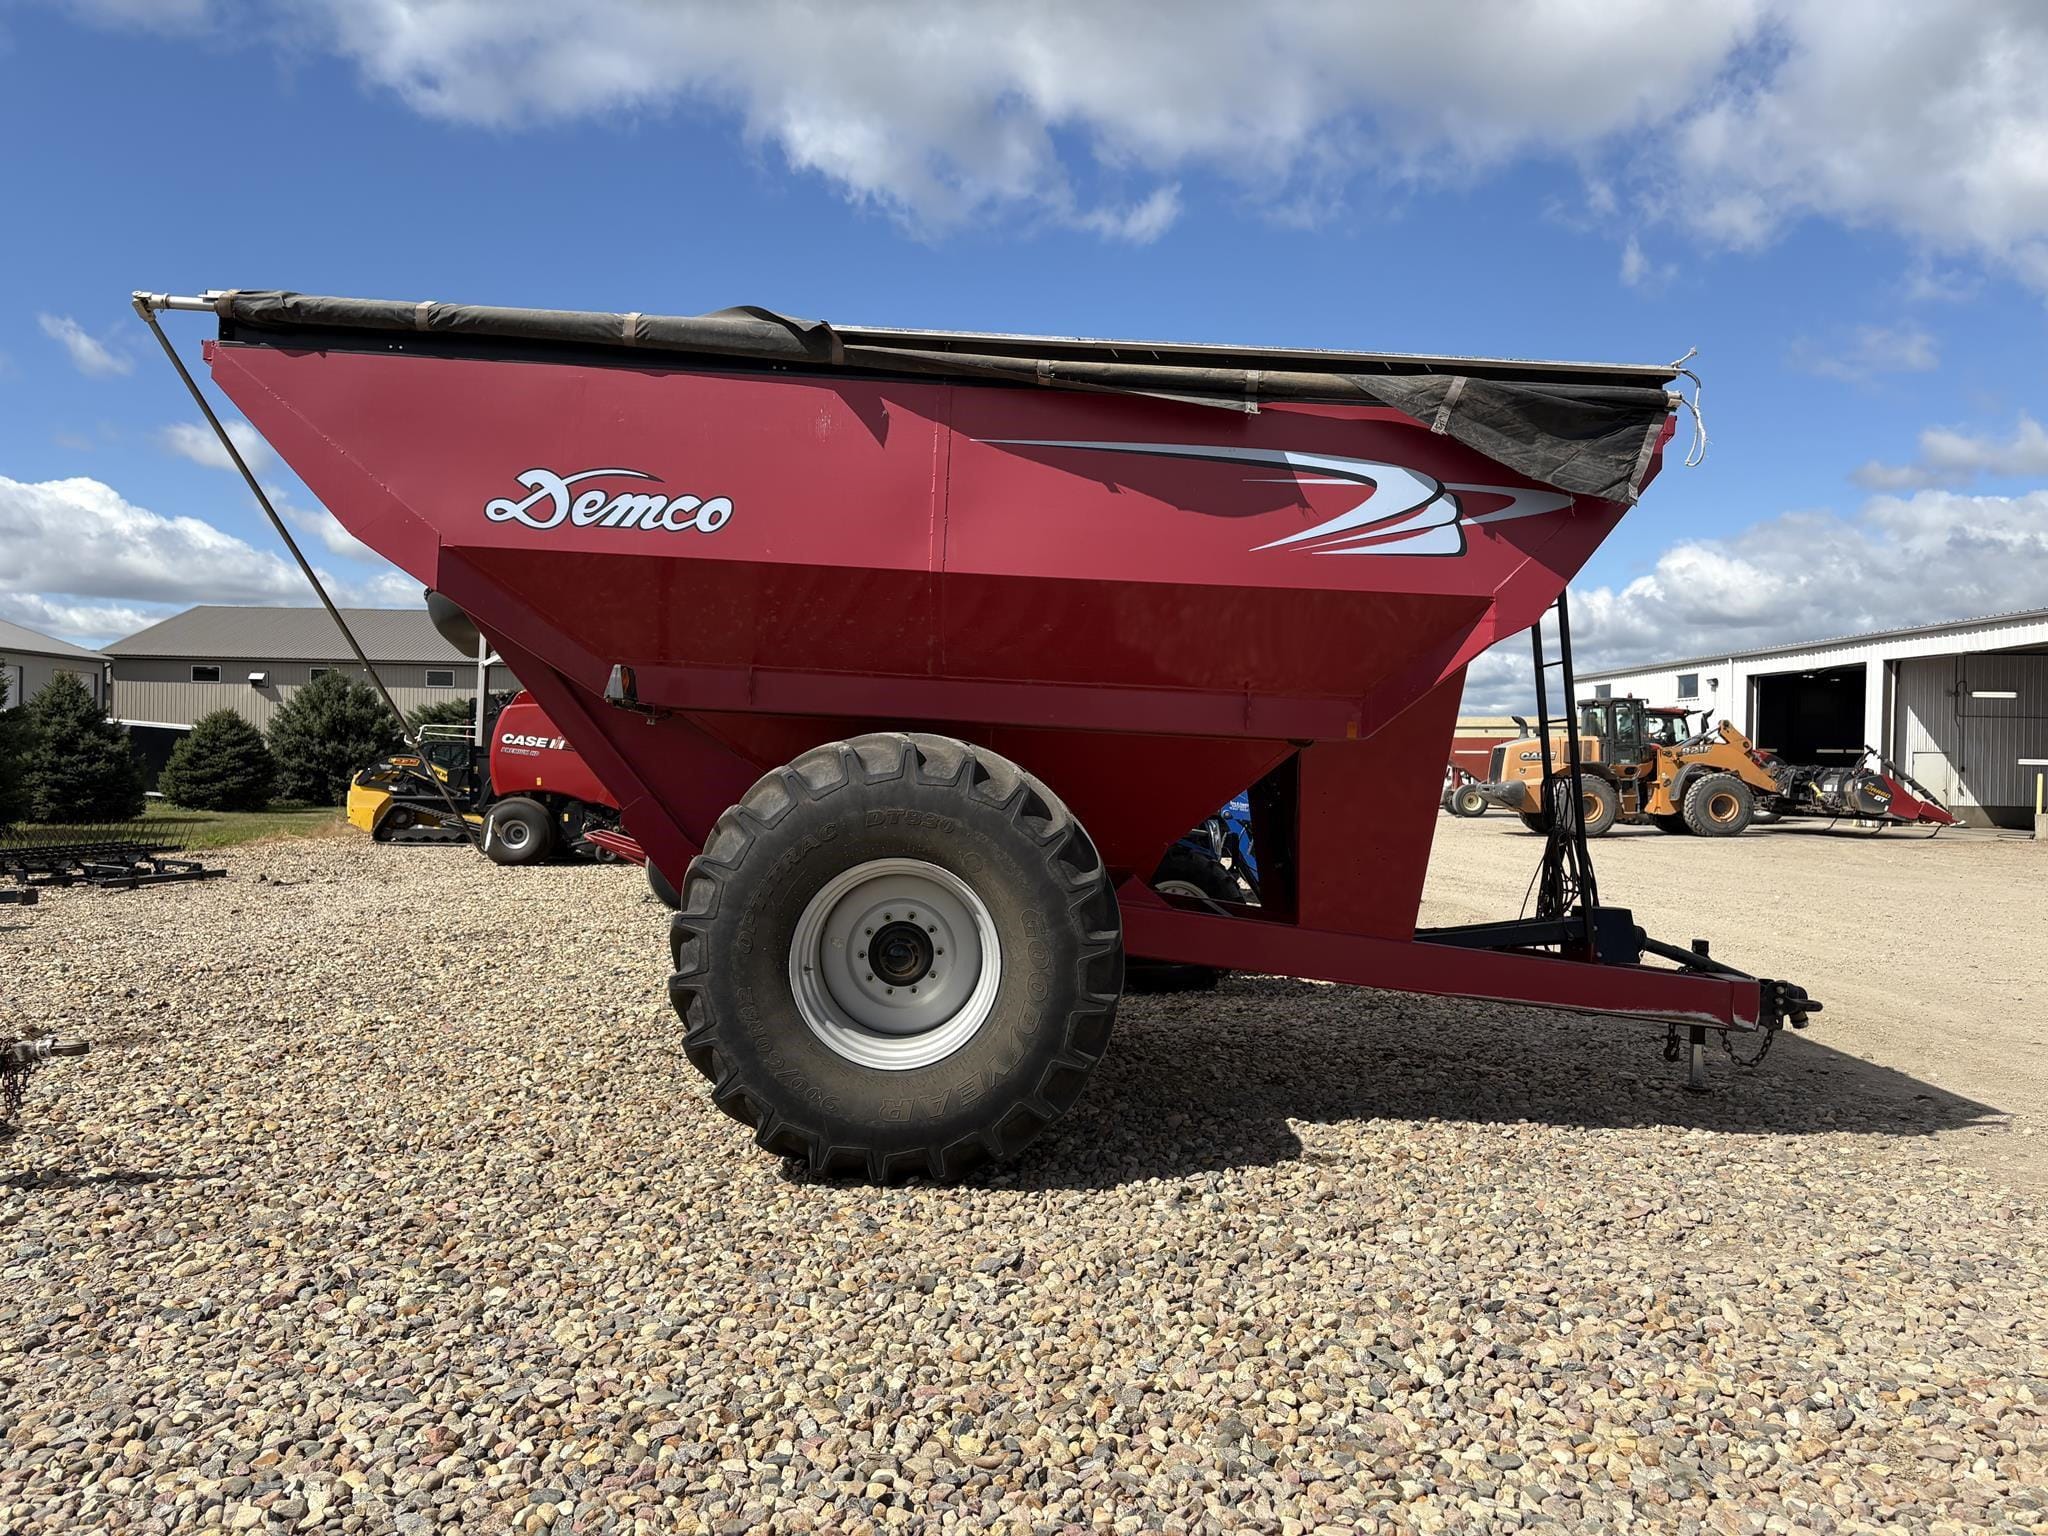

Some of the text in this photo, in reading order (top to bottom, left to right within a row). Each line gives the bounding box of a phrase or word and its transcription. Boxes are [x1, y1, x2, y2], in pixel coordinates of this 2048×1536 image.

[484, 468, 734, 534] Demco
[501, 733, 549, 749] CASE
[878, 909, 1050, 1123] GOODYEAR
